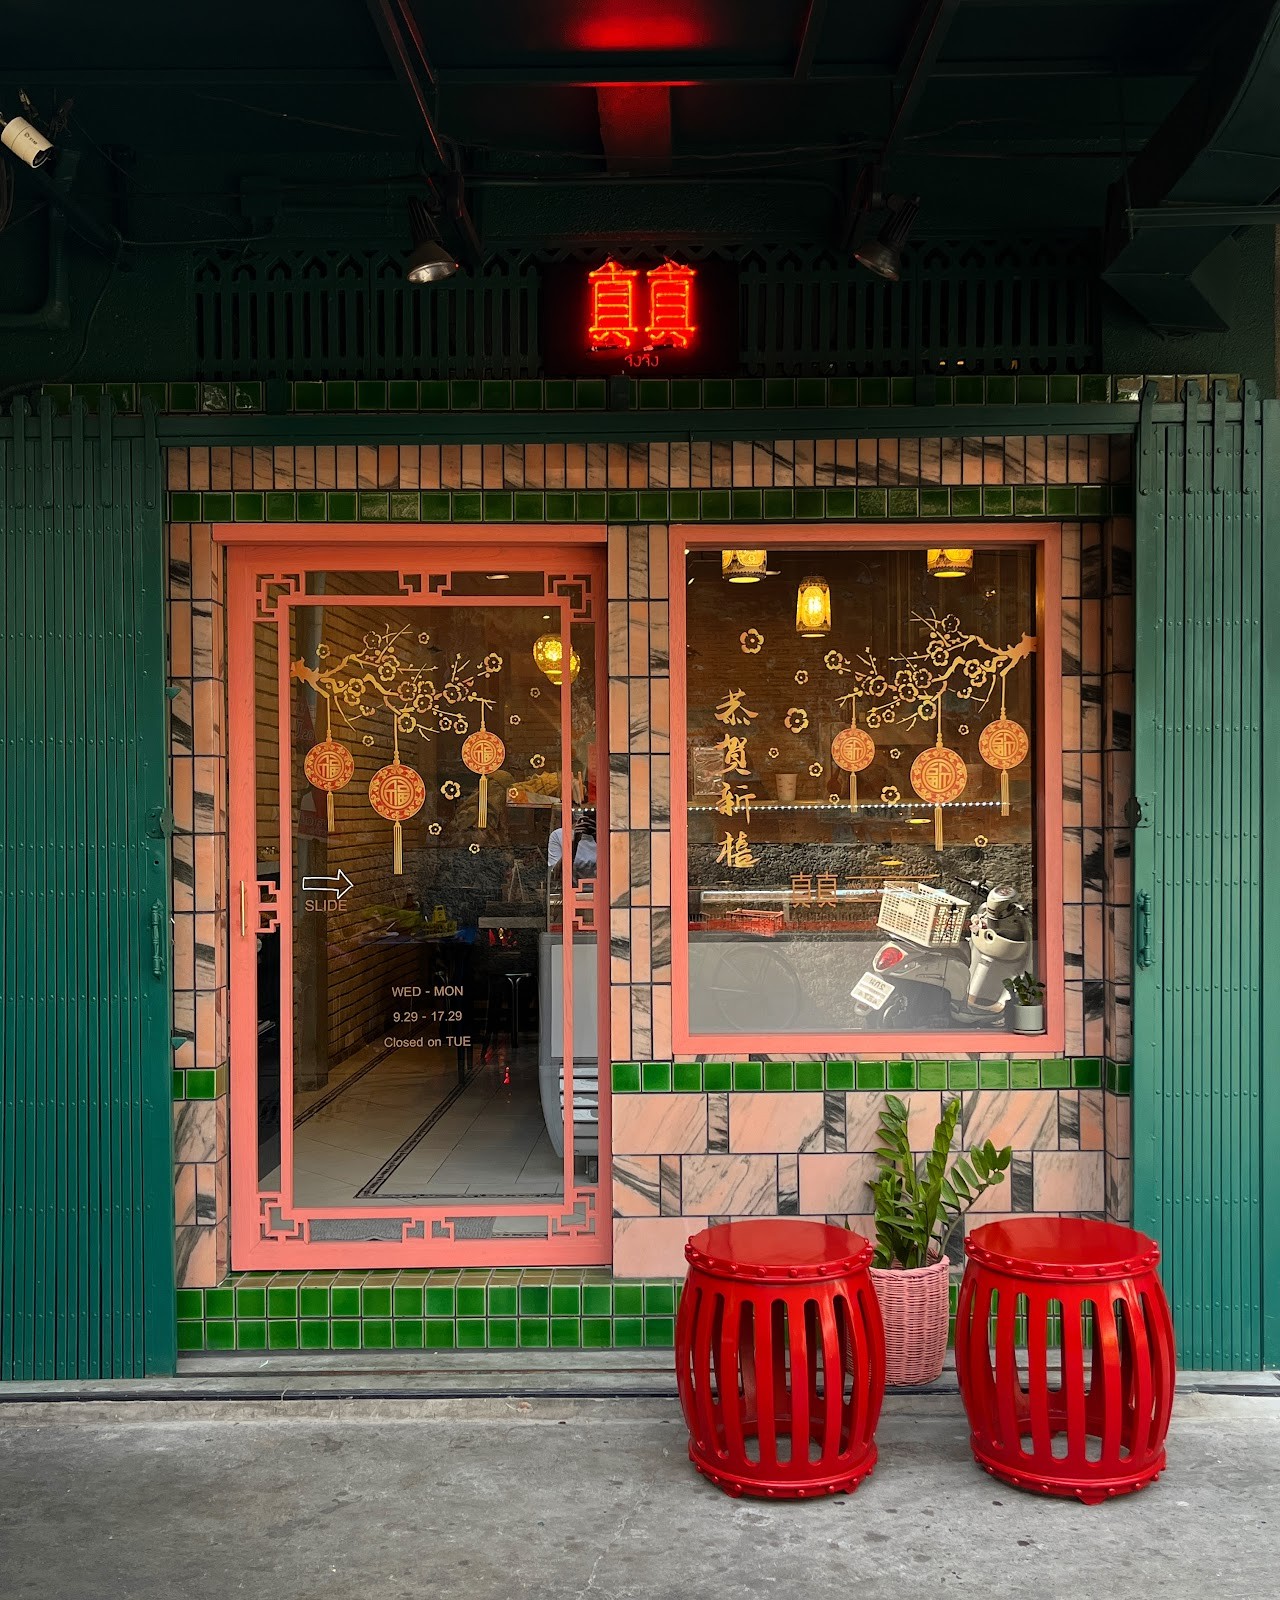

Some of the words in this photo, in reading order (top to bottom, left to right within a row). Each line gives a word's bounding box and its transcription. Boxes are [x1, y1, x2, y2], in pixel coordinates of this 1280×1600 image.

[317, 753, 343, 780] 福
[382, 778, 411, 807] 福
[304, 900, 348, 912] SLIDE
[391, 986, 422, 997] WED
[433, 985, 464, 997] MON
[393, 1011, 419, 1022] 9.29
[430, 1010, 463, 1022] 17.29
[383, 1036, 424, 1048] Closed
[427, 1038, 442, 1048] on
[445, 1036, 472, 1047] TUE
